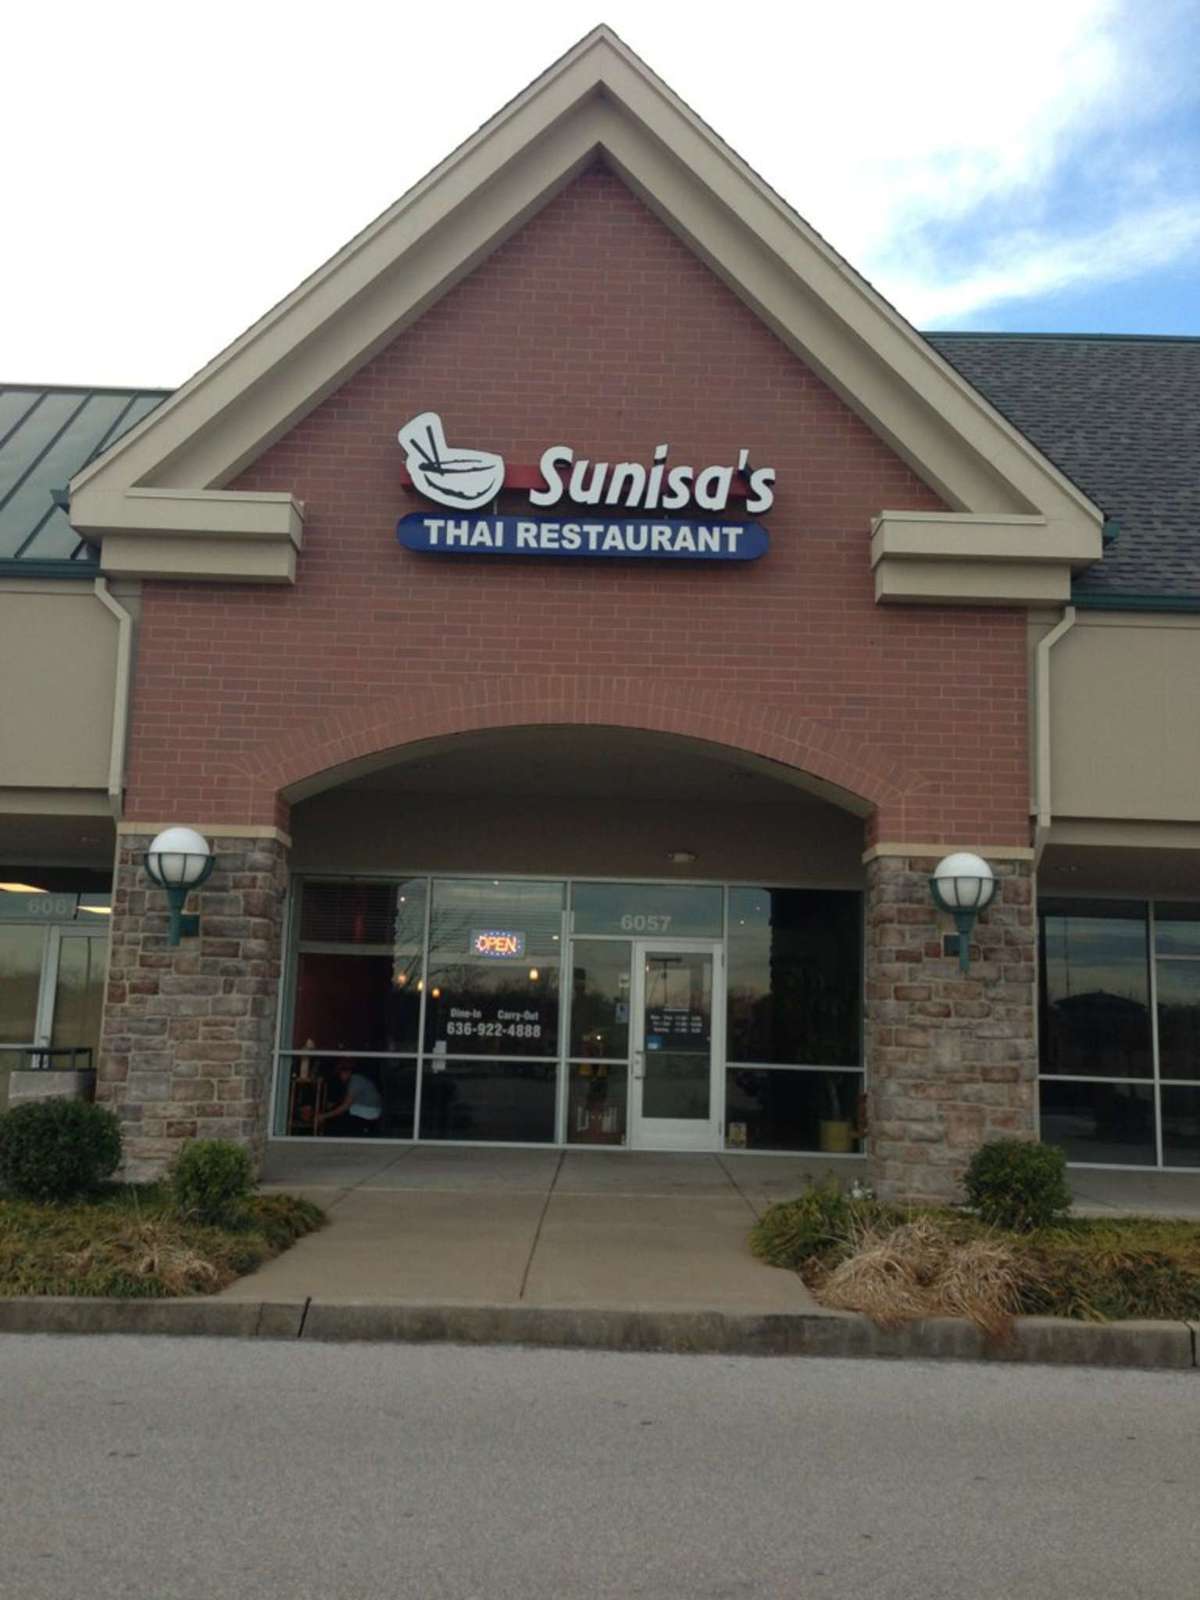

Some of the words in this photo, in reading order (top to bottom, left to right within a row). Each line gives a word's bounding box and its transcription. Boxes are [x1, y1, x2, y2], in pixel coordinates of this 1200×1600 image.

[529, 444, 776, 514] Sunisa's
[423, 519, 504, 547] THAI
[516, 522, 744, 553] RESTAURANT
[621, 914, 672, 932] 6057
[477, 935, 517, 951] OPEN
[447, 1022, 541, 1038] 636-922-4888
